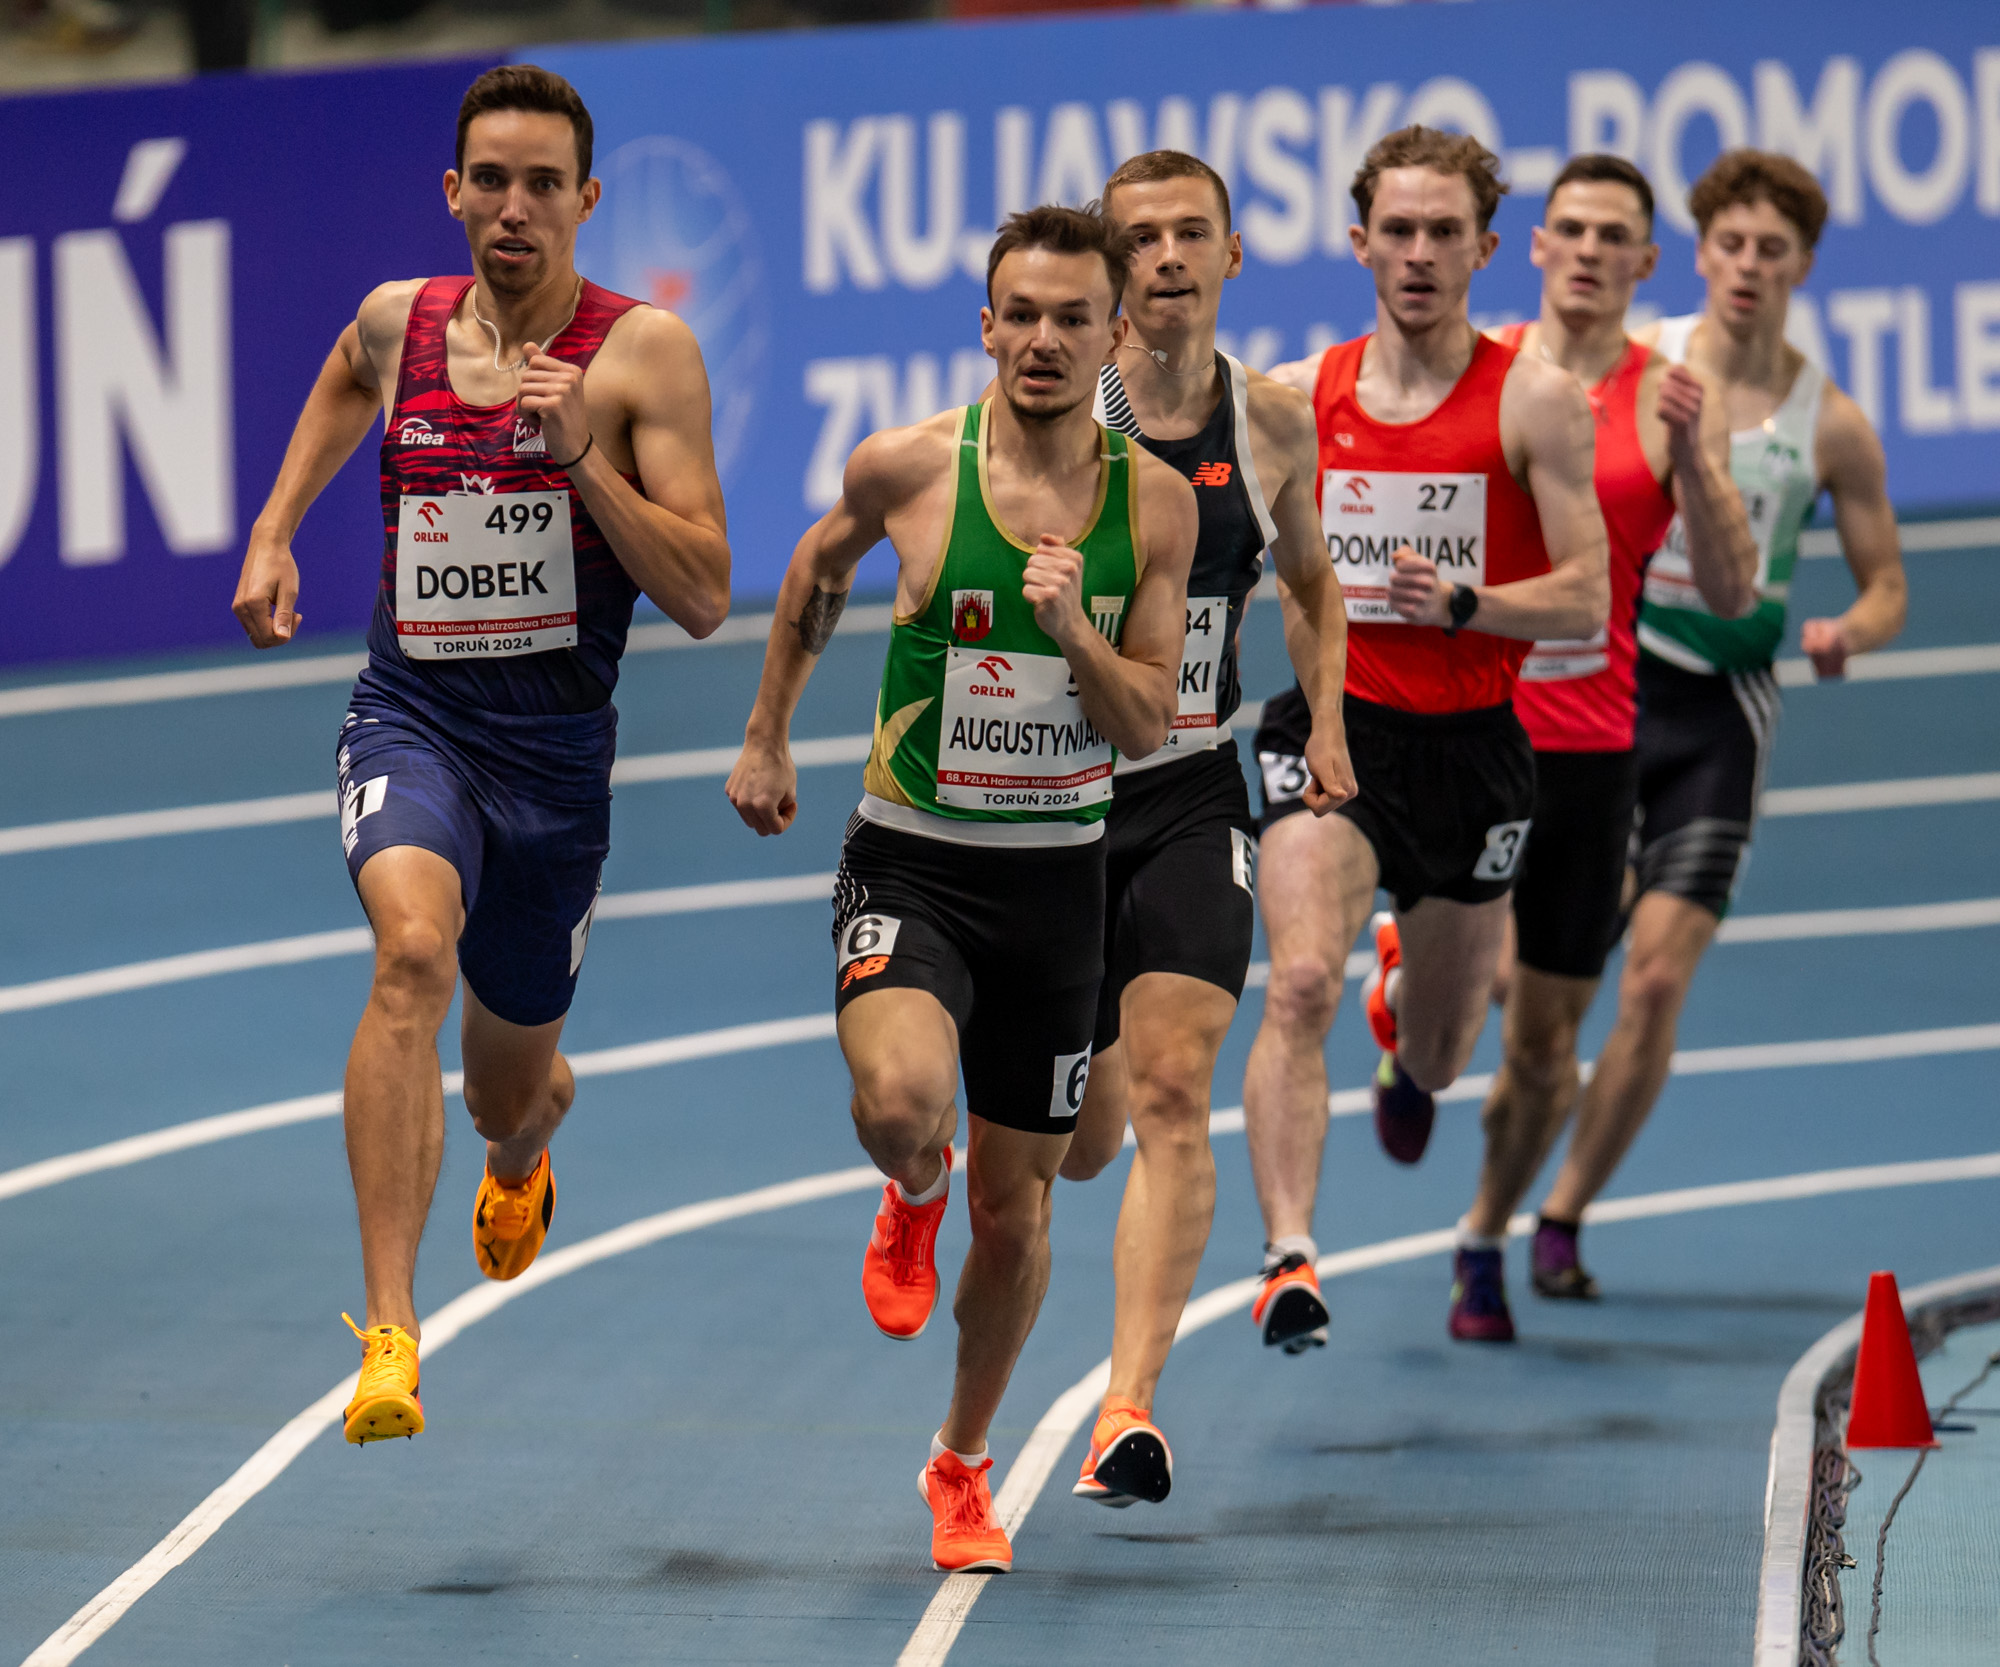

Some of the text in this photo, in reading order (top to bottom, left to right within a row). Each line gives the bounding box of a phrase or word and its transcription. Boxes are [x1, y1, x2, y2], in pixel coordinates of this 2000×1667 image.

[0, 136, 236, 570] Ń
[400, 428, 445, 446] Enea
[1340, 503, 1374, 514] ORLEN
[1418, 483, 1459, 512] 27
[485, 502, 553, 534] 499
[414, 532, 449, 543] ORLEN
[417, 561, 548, 599] DOBEK
[1353, 603, 1394, 616] TORU
[403, 613, 571, 633] 68. PZLA Halowe Mistrzostwa Polski
[434, 636, 533, 653] TORUŃ 2024
[1176, 661, 1211, 694] KI
[969, 685, 1015, 698] ORLEN
[1187, 715, 1211, 725] Polski
[946, 766, 1107, 787] 68. PZLA Halowe Mistrzostwa Polski
[1278, 758, 1306, 793] 3
[349, 785, 367, 820] 1
[983, 791, 1079, 805] TORUŃ 2024
[1490, 829, 1519, 873] 3
[848, 917, 883, 955] 6
[1066, 1055, 1087, 1109] 6
